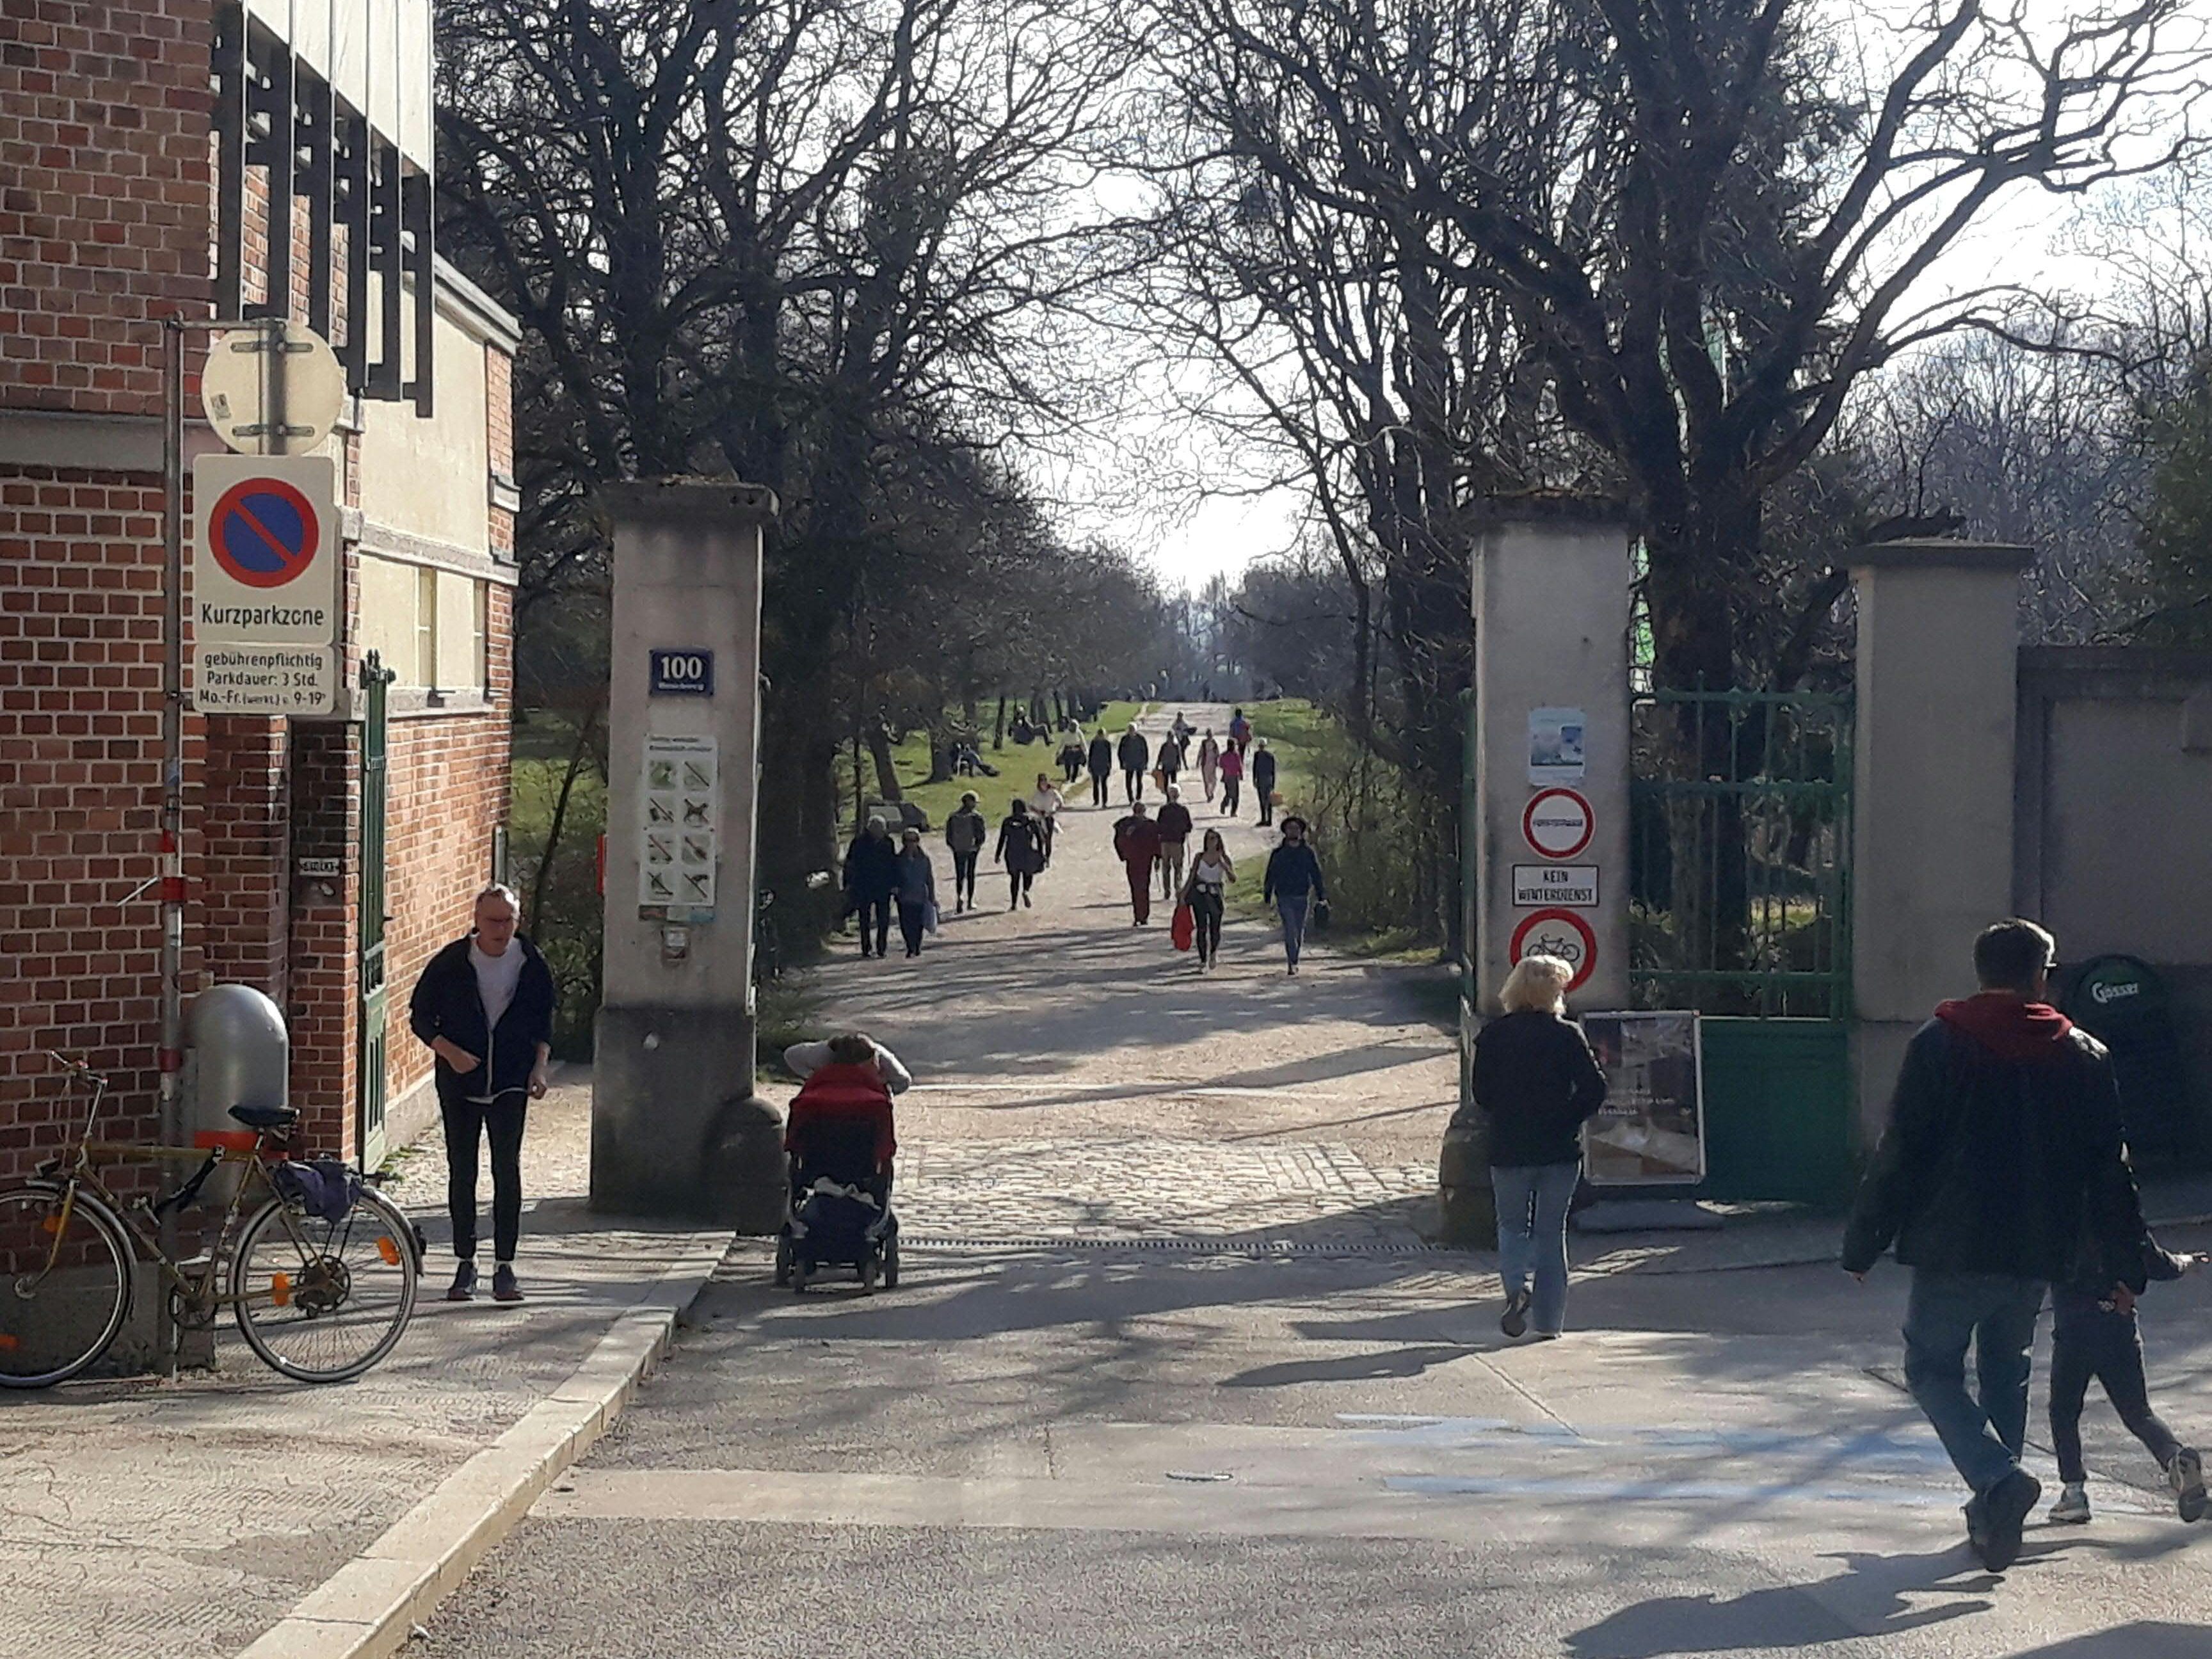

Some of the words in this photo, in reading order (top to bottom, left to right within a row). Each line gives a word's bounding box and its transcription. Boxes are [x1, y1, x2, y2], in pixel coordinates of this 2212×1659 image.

[202, 603, 324, 628] Kurzparkzone
[661, 656, 703, 679] 100
[207, 671, 278, 686] Parkdauer:
[282, 673, 289, 686] 3
[293, 672, 318, 687] Std.
[1543, 870, 1569, 883] KEIN
[1518, 888, 1592, 901] WINTERDIENST
